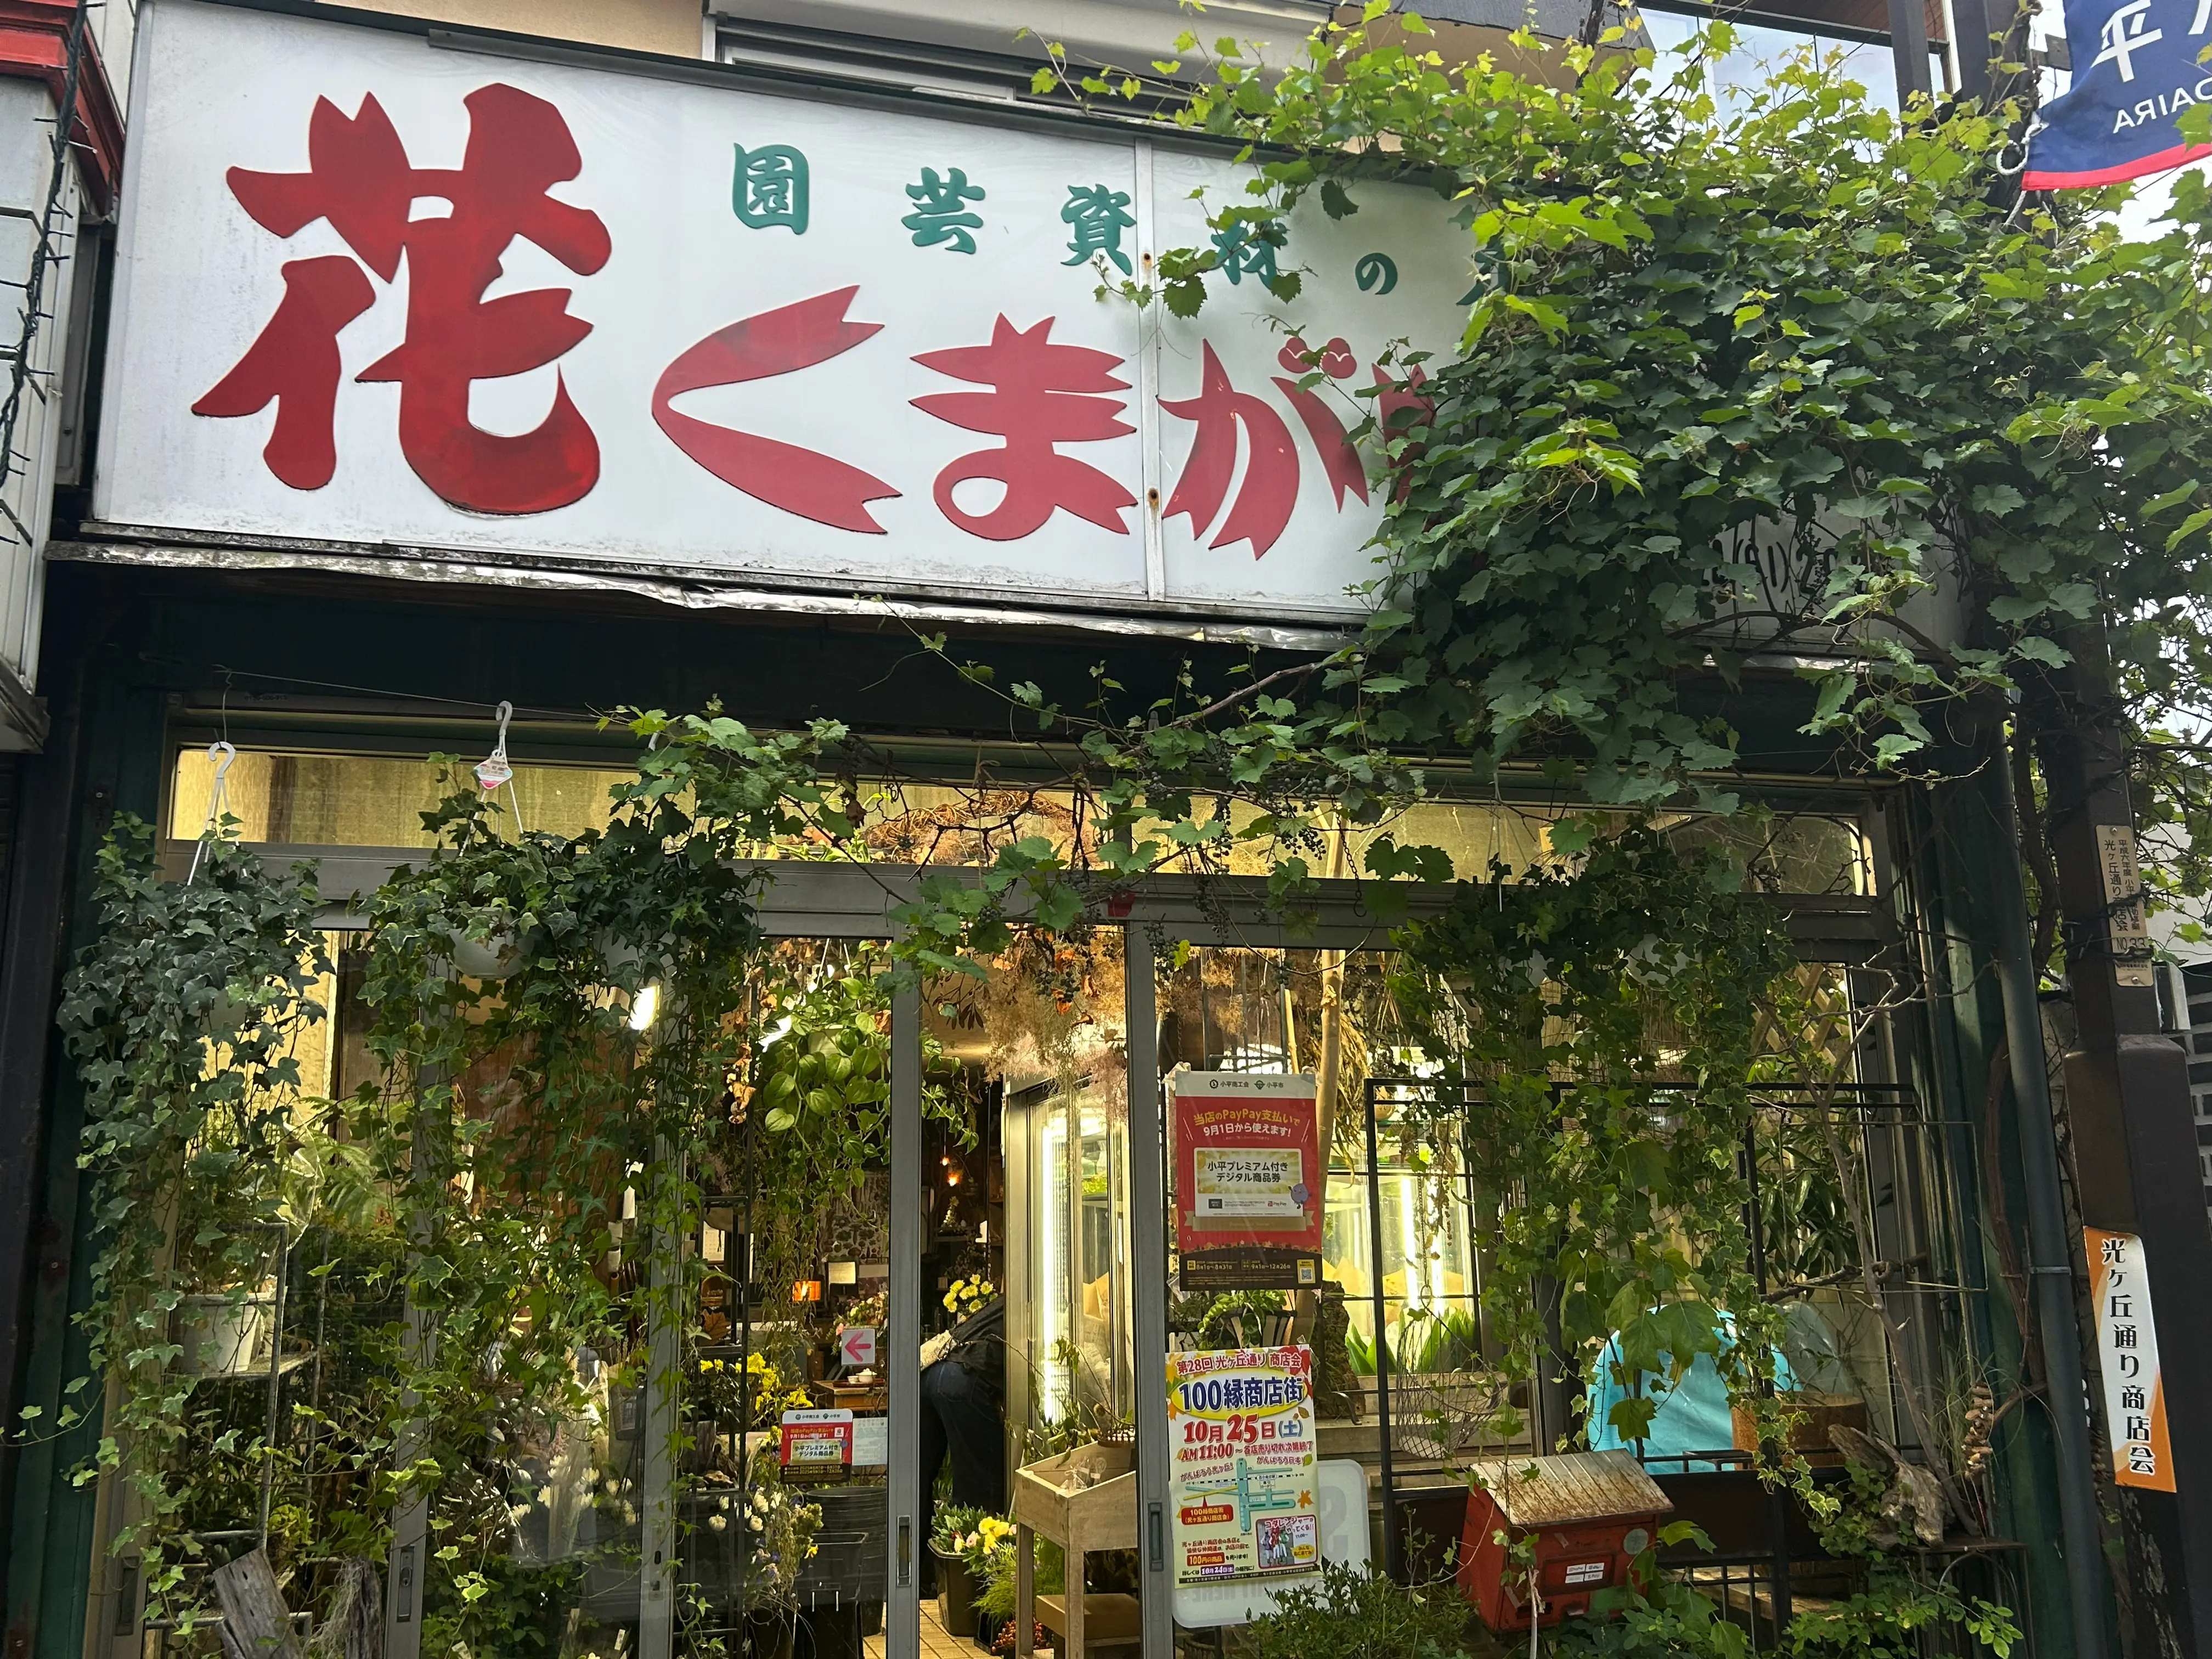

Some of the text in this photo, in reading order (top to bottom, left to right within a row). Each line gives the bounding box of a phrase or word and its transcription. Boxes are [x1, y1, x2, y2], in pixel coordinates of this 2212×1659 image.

[1193, 1108, 1300, 1126] 当店のPayPay支払いで
[1207, 1161, 1288, 1172] 小平プレミアム付き
[1216, 1172, 1281, 1183] デジタル商品券
[1177, 1357, 1213, 1374] 第28回
[1269, 1353, 1302, 1368] 商店会
[1179, 1377, 1304, 1412] 100縁商店街
